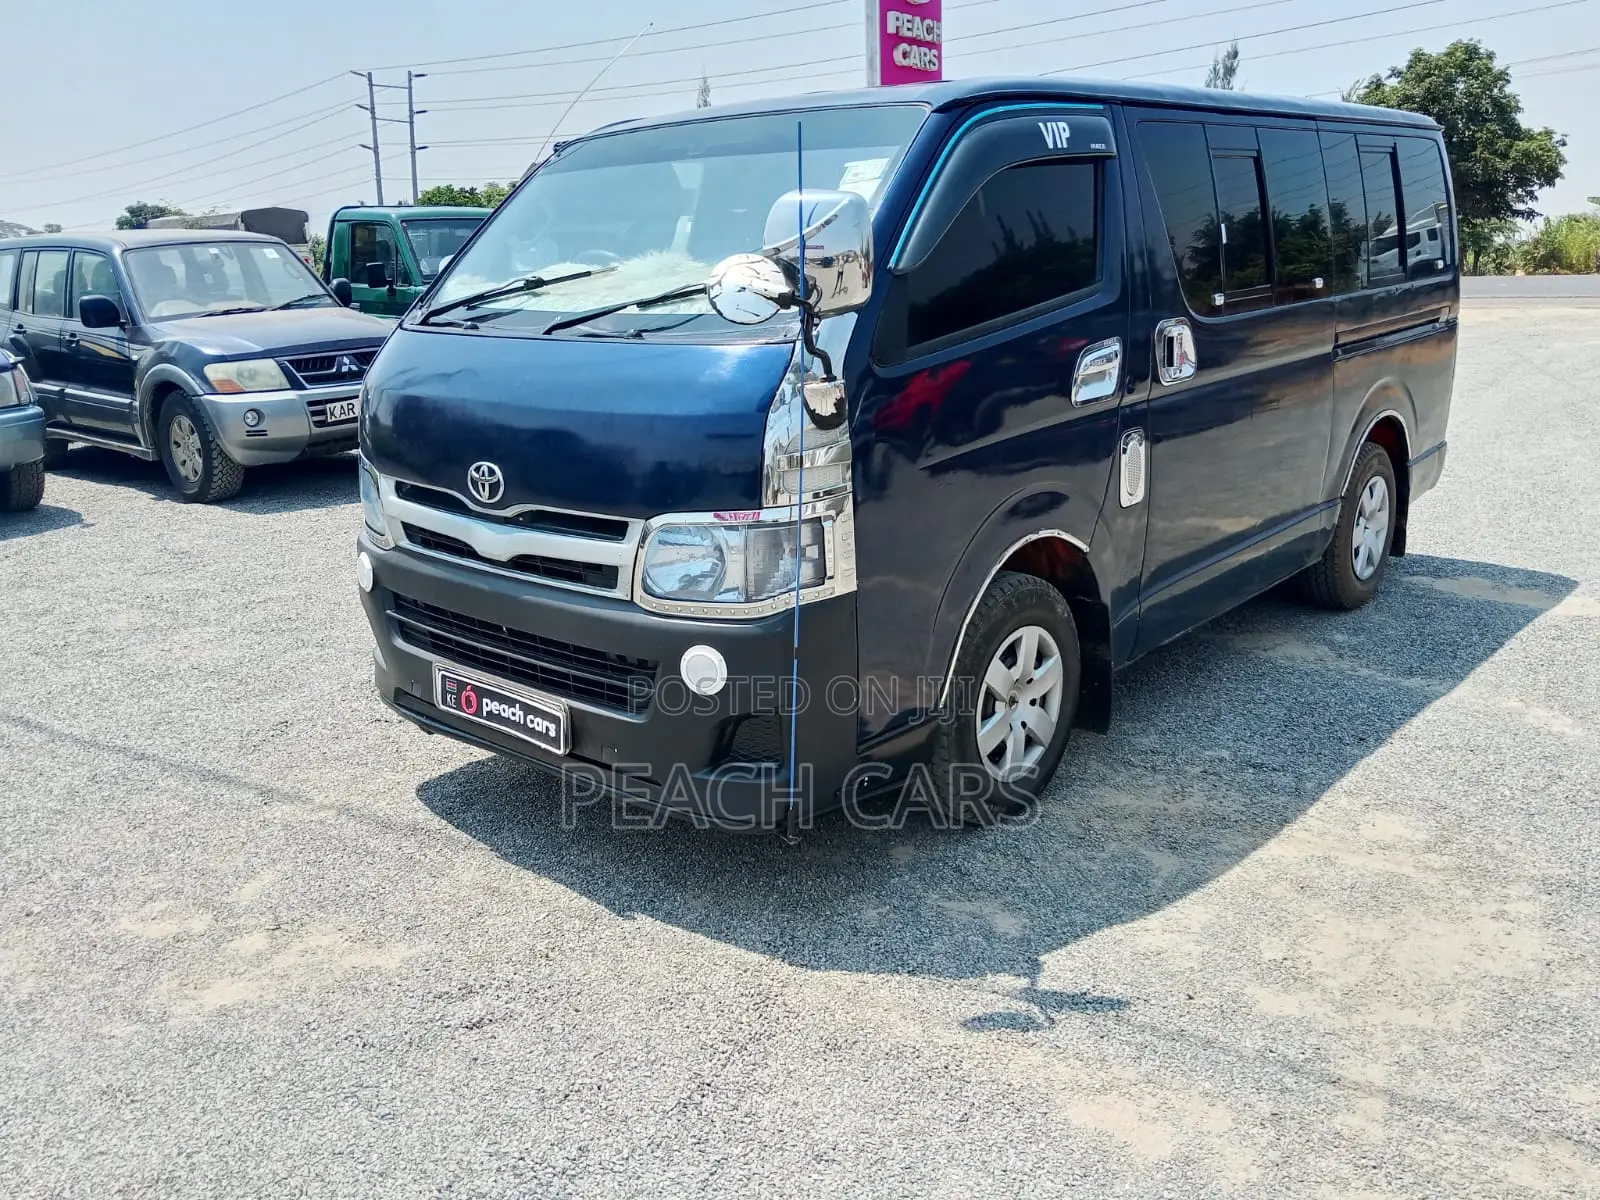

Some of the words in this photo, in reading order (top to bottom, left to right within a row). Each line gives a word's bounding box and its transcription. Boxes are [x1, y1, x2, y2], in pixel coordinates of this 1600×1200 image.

[886, 10, 942, 44] PEACH
[893, 43, 939, 72] CARS
[1037, 121, 1071, 150] VIP
[328, 402, 356, 420] KAR
[446, 692, 457, 708] KE
[482, 698, 524, 725] peach
[526, 714, 557, 738] cars
